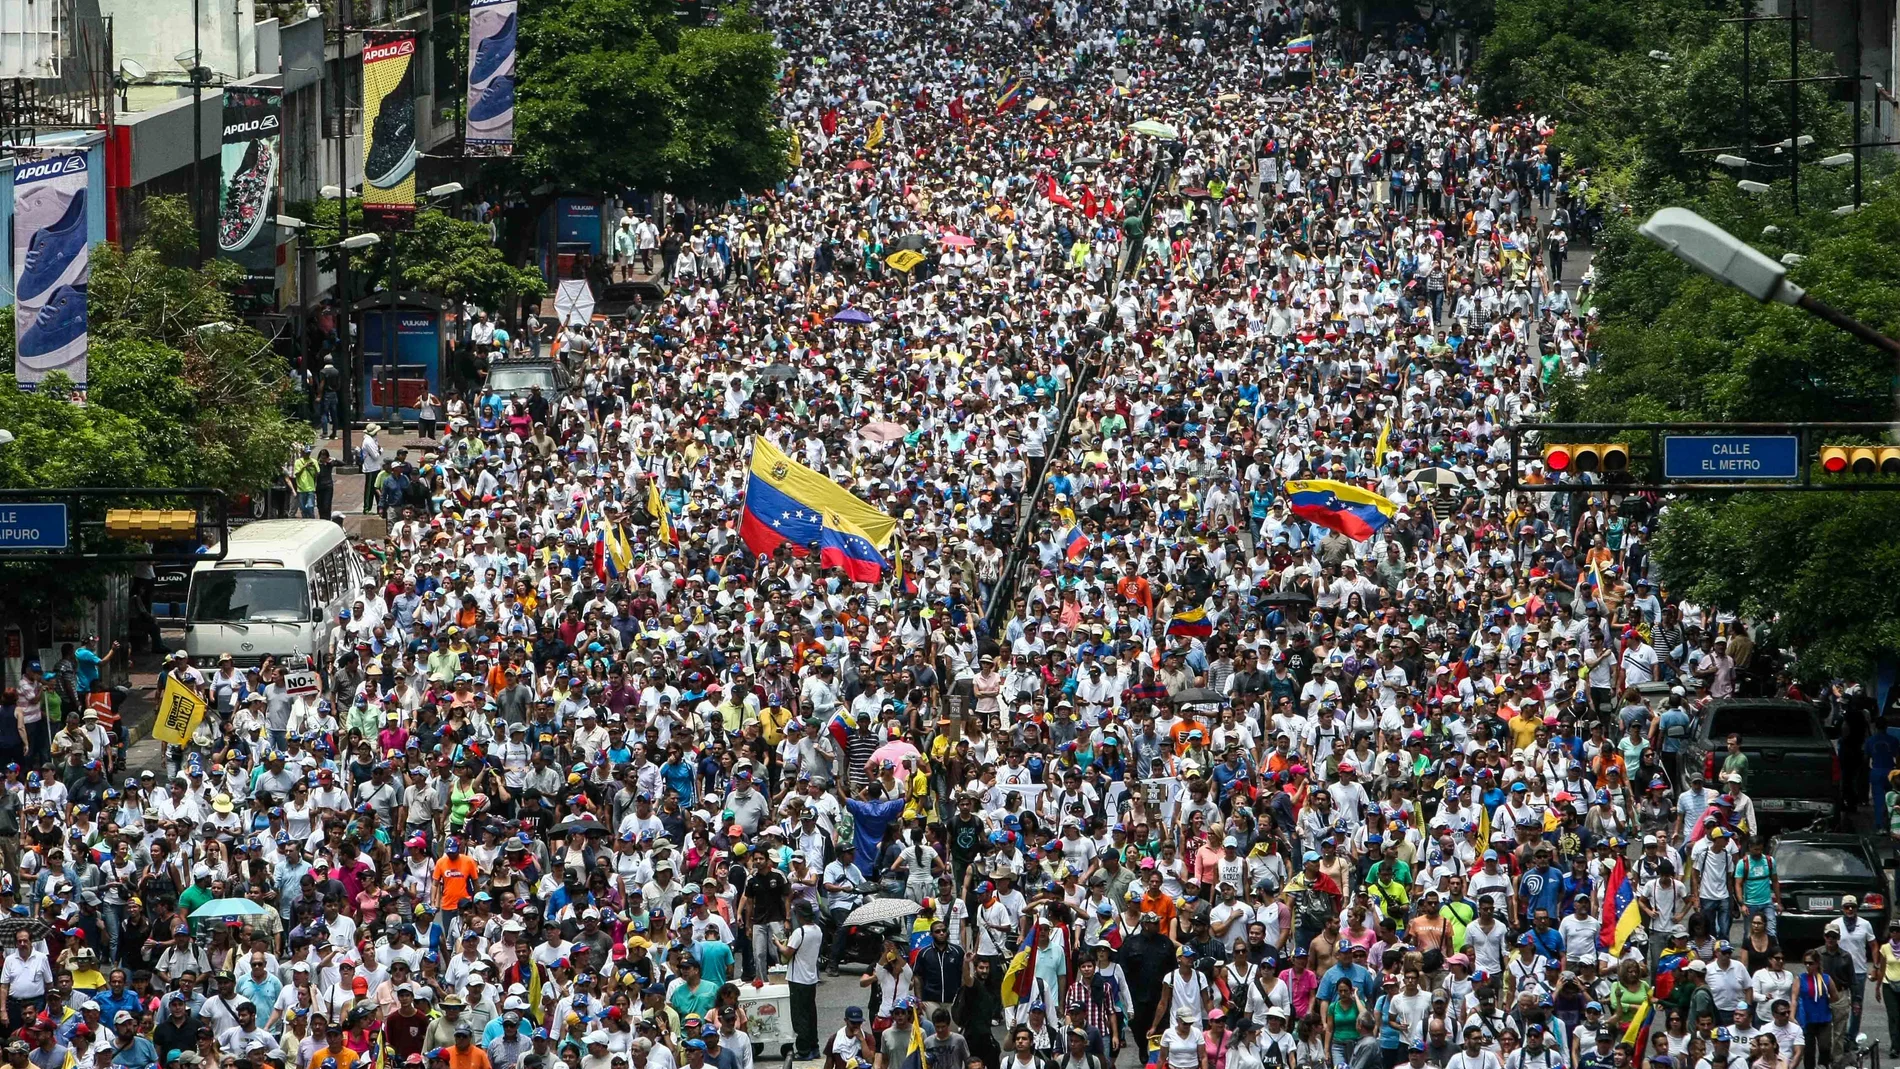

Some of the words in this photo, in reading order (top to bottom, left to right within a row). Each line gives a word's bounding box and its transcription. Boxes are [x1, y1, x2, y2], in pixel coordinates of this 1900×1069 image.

[365, 46, 398, 61] APOLO
[223, 120, 260, 137] APOLO
[15, 161, 63, 181] APOLO
[1712, 444, 1751, 455] CALLE
[1701, 460, 1717, 470] EL
[1719, 460, 1761, 470] METRO
